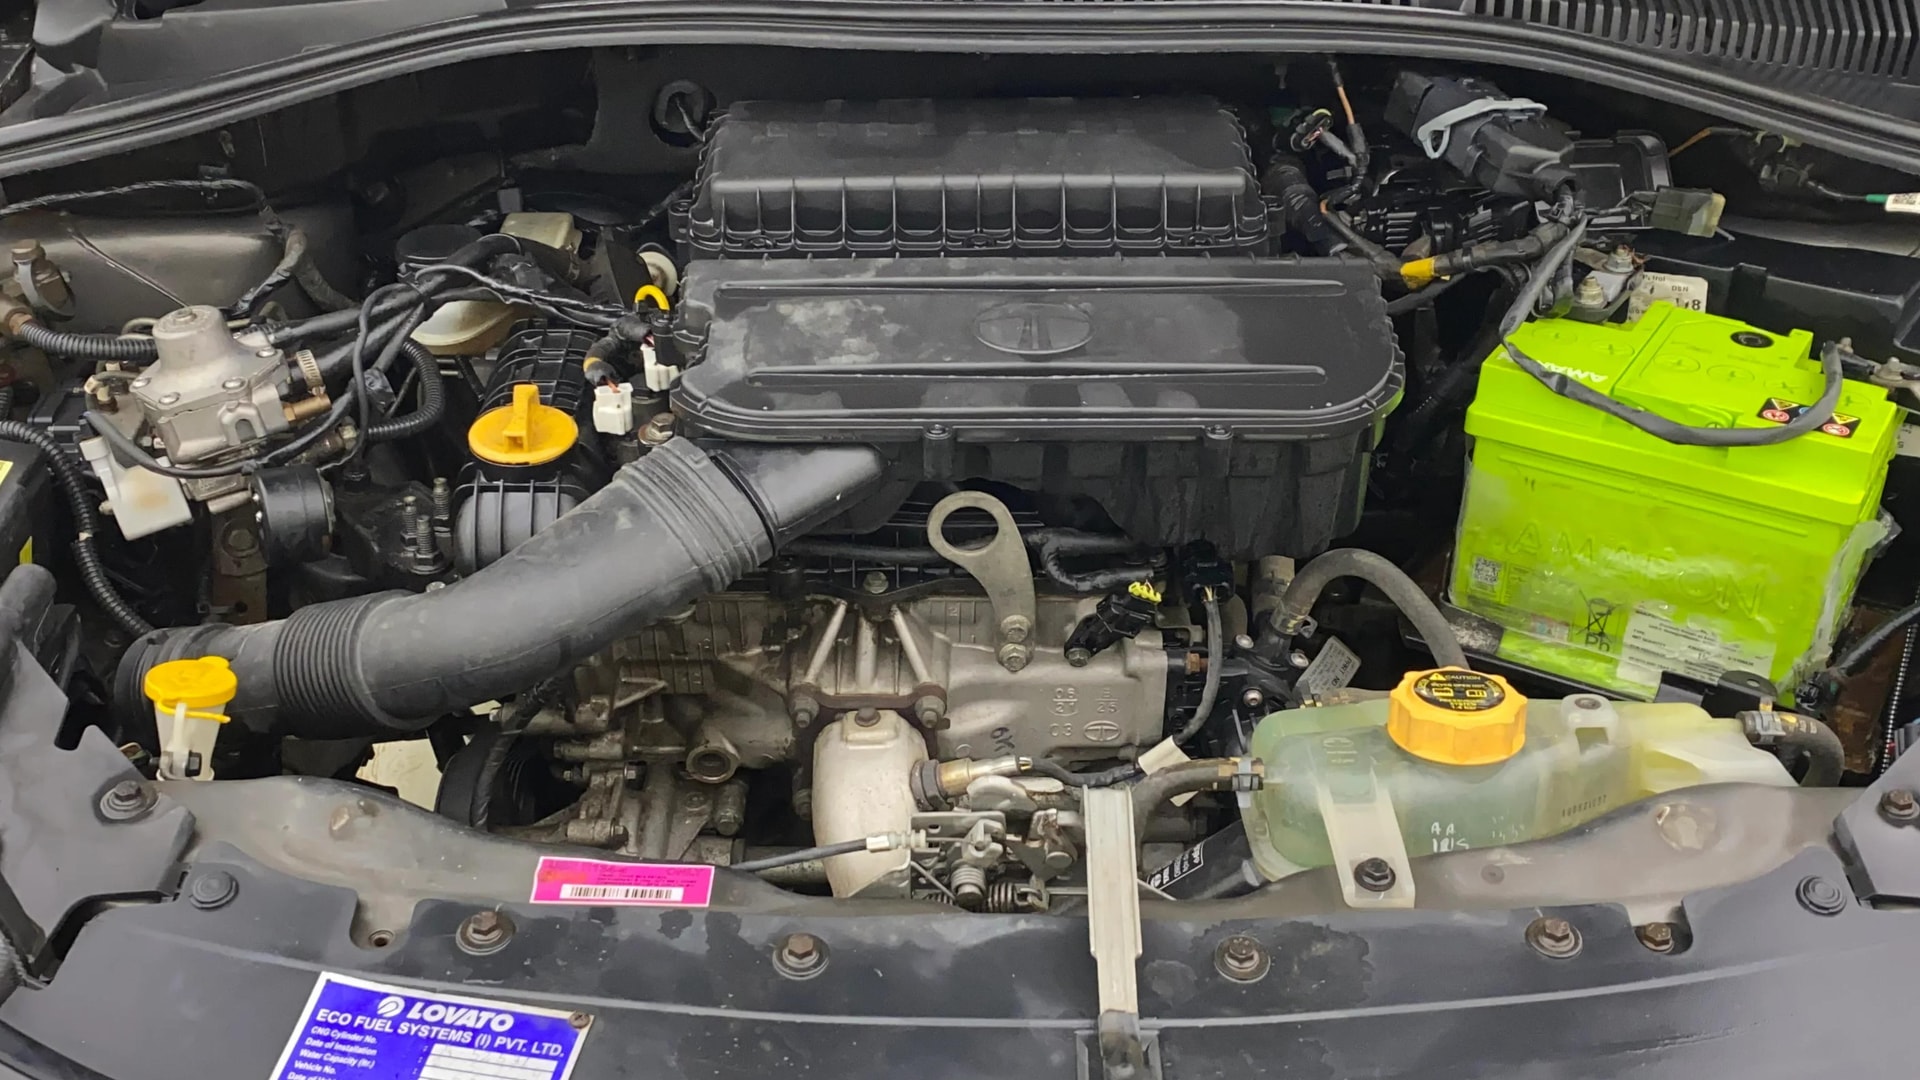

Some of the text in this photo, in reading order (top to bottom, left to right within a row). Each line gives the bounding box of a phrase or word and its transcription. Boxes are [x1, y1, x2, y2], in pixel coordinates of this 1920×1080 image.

[406, 1002, 514, 1032] LOVATO
[311, 1026, 377, 1044] CNG Cylinder No.
[316, 1008, 352, 1026] ECO
[353, 1015, 394, 1032] FUEL
[397, 1022, 473, 1043] SYSTEMS
[474, 1034, 492, 1049] (I)
[493, 1037, 527, 1052] PVT.
[531, 1042, 565, 1057] LTD.
[304, 1037, 378, 1056] Date of Installation
[299, 1048, 323, 1059] Water
[323, 1053, 359, 1067] Capacity
[294, 1060, 337, 1075] Vehicle No.
